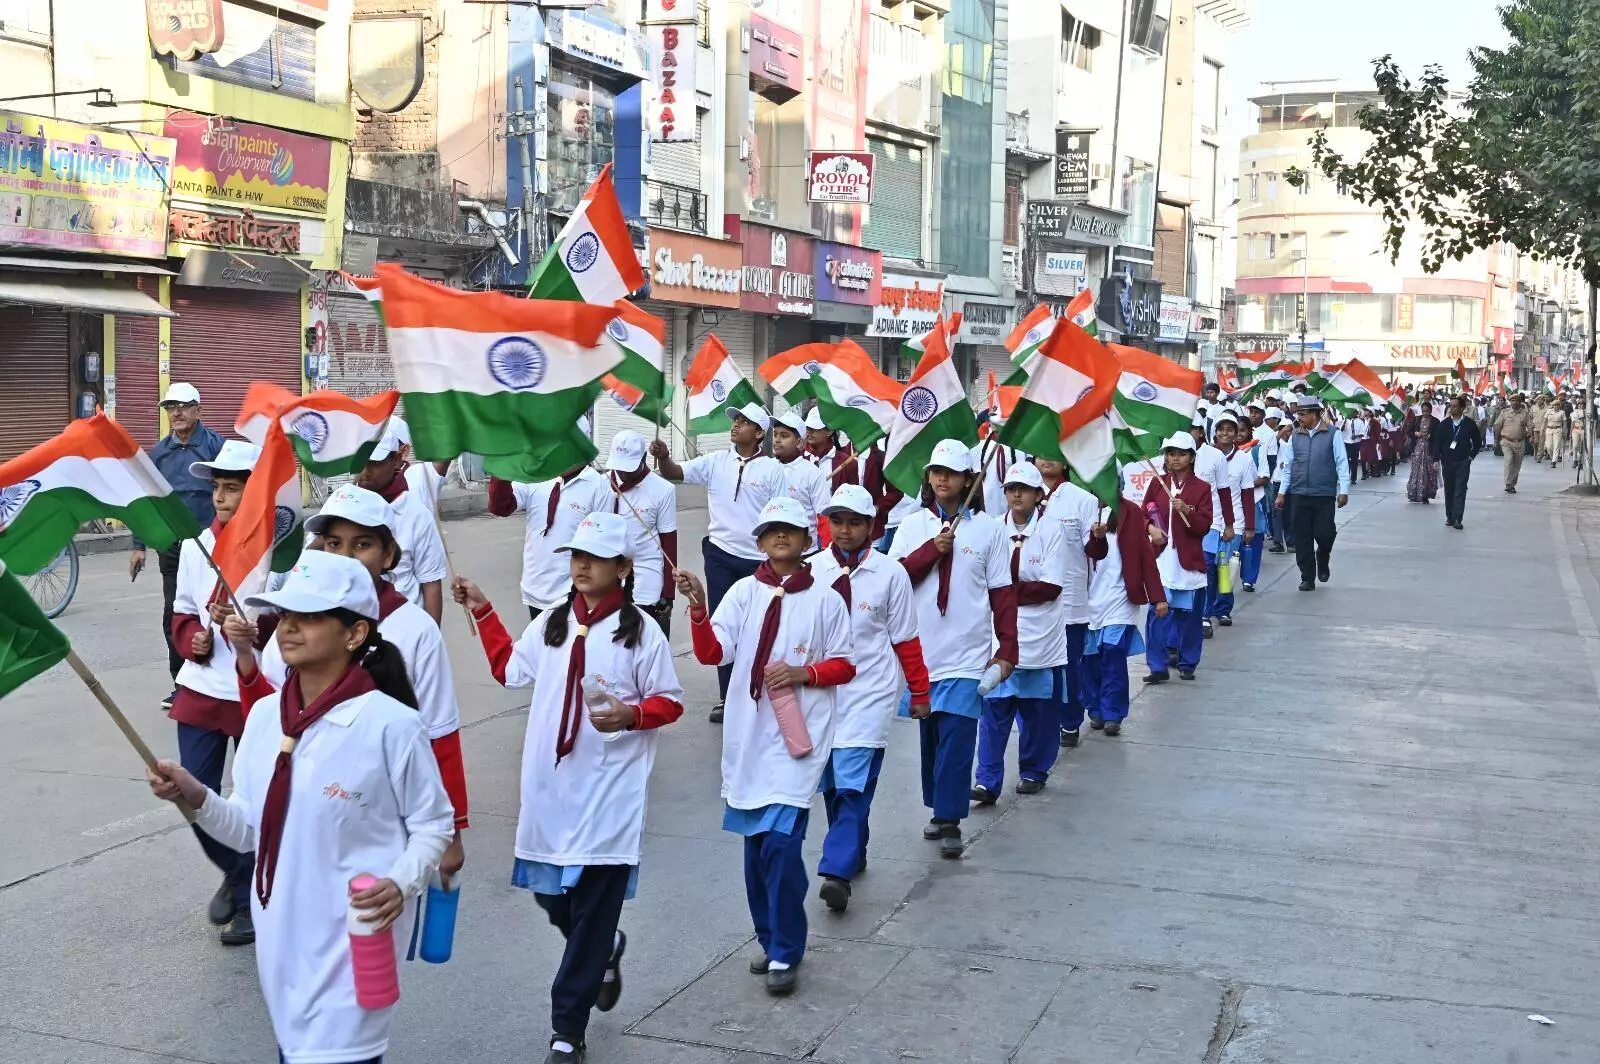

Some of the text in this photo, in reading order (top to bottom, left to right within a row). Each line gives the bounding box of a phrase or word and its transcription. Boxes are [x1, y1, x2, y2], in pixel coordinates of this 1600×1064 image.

[1058, 161, 1087, 171] GEM
[816, 172, 866, 186] ROYAL
[206, 185, 234, 198] PAINT
[236, 190, 243, 199] &
[245, 191, 264, 202] H/W
[820, 185, 860, 193] ATTIRE
[1030, 203, 1068, 216] SILVER
[1047, 257, 1083, 271] SILVER
[742, 266, 777, 298] ROYAL
[778, 270, 815, 300] ATTIRE
[875, 317, 909, 334] ADVANCE
[1390, 343, 1442, 361] SADRI
